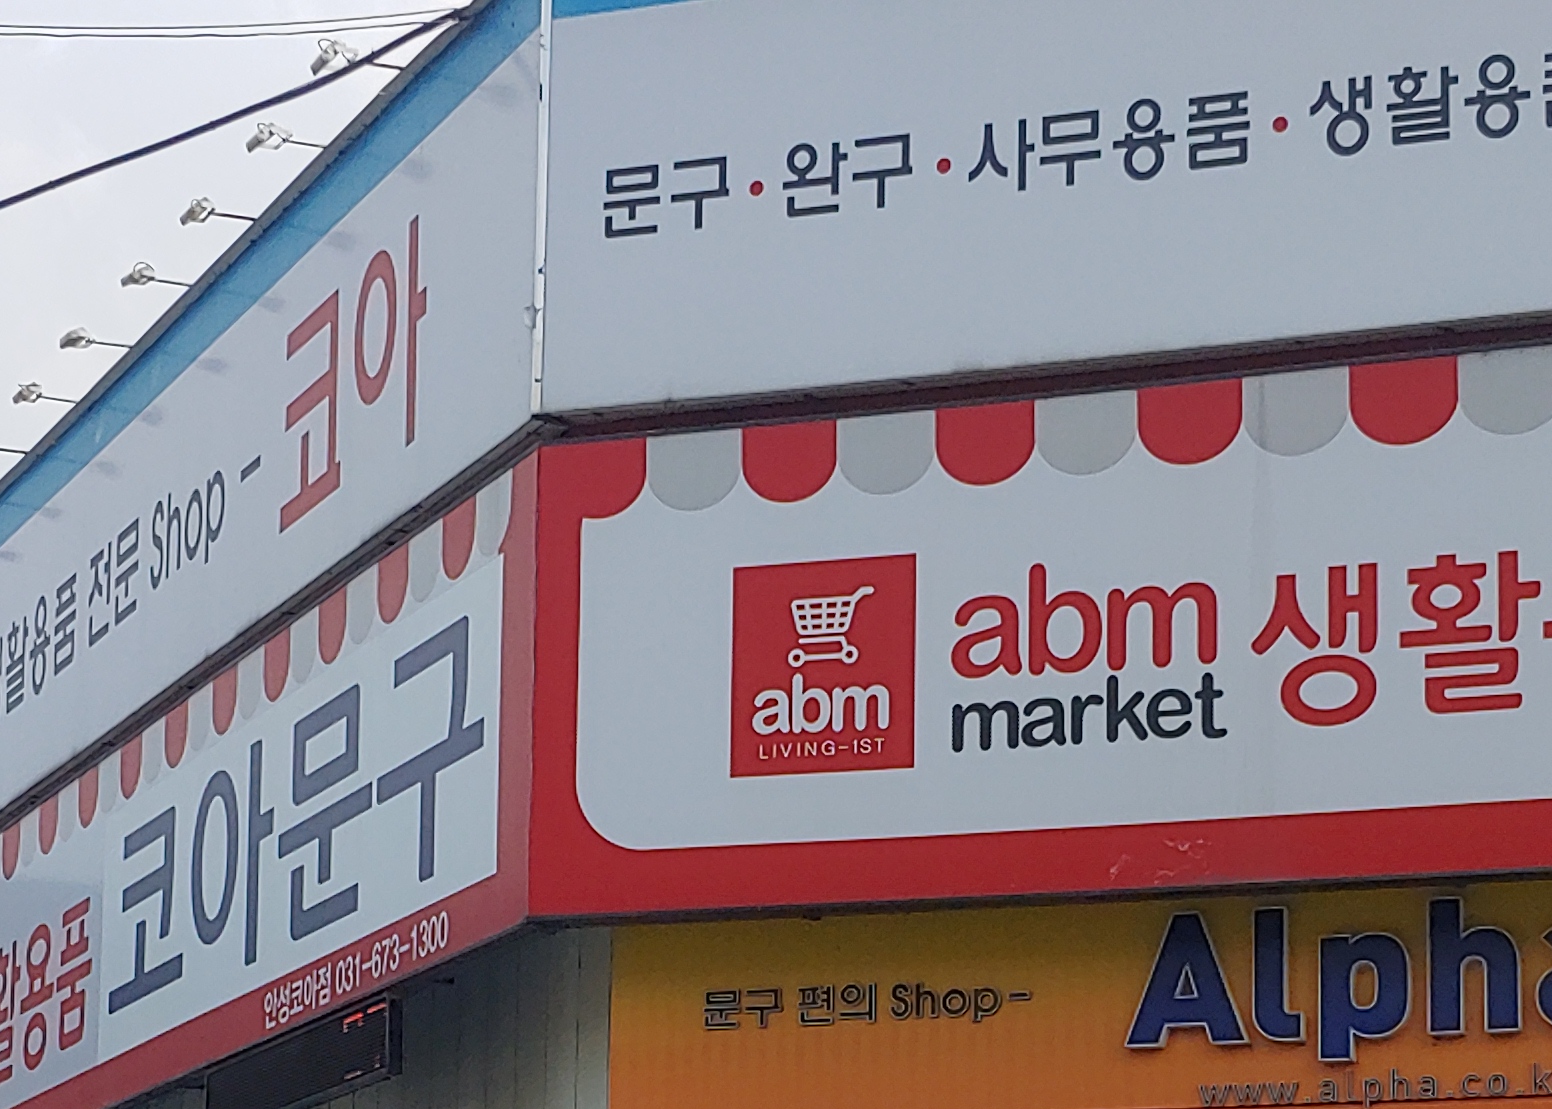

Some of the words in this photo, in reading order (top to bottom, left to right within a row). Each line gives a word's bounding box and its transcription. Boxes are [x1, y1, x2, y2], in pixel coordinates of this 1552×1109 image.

[603, 156, 730, 238] 문구
[782, 133, 913, 217] 완구
[968, 90, 1250, 191] 사무용품
[280, 215, 427, 534] 코아
[89, 517, 139, 648] 전문
[149, 470, 225, 590] Shop
[950, 563, 1217, 679] abm
[752, 673, 890, 735] abm
[758, 737, 885, 760] LIVING-1ST
[952, 672, 1228, 754] market
[109, 616, 485, 1015] 코아문구
[263, 965, 332, 1031] 안성코아점
[336, 911, 449, 991] 031-673-1300
[702, 985, 784, 1031] 문구
[798, 982, 878, 1027] 편의
[890, 981, 1002, 1026] Shop
